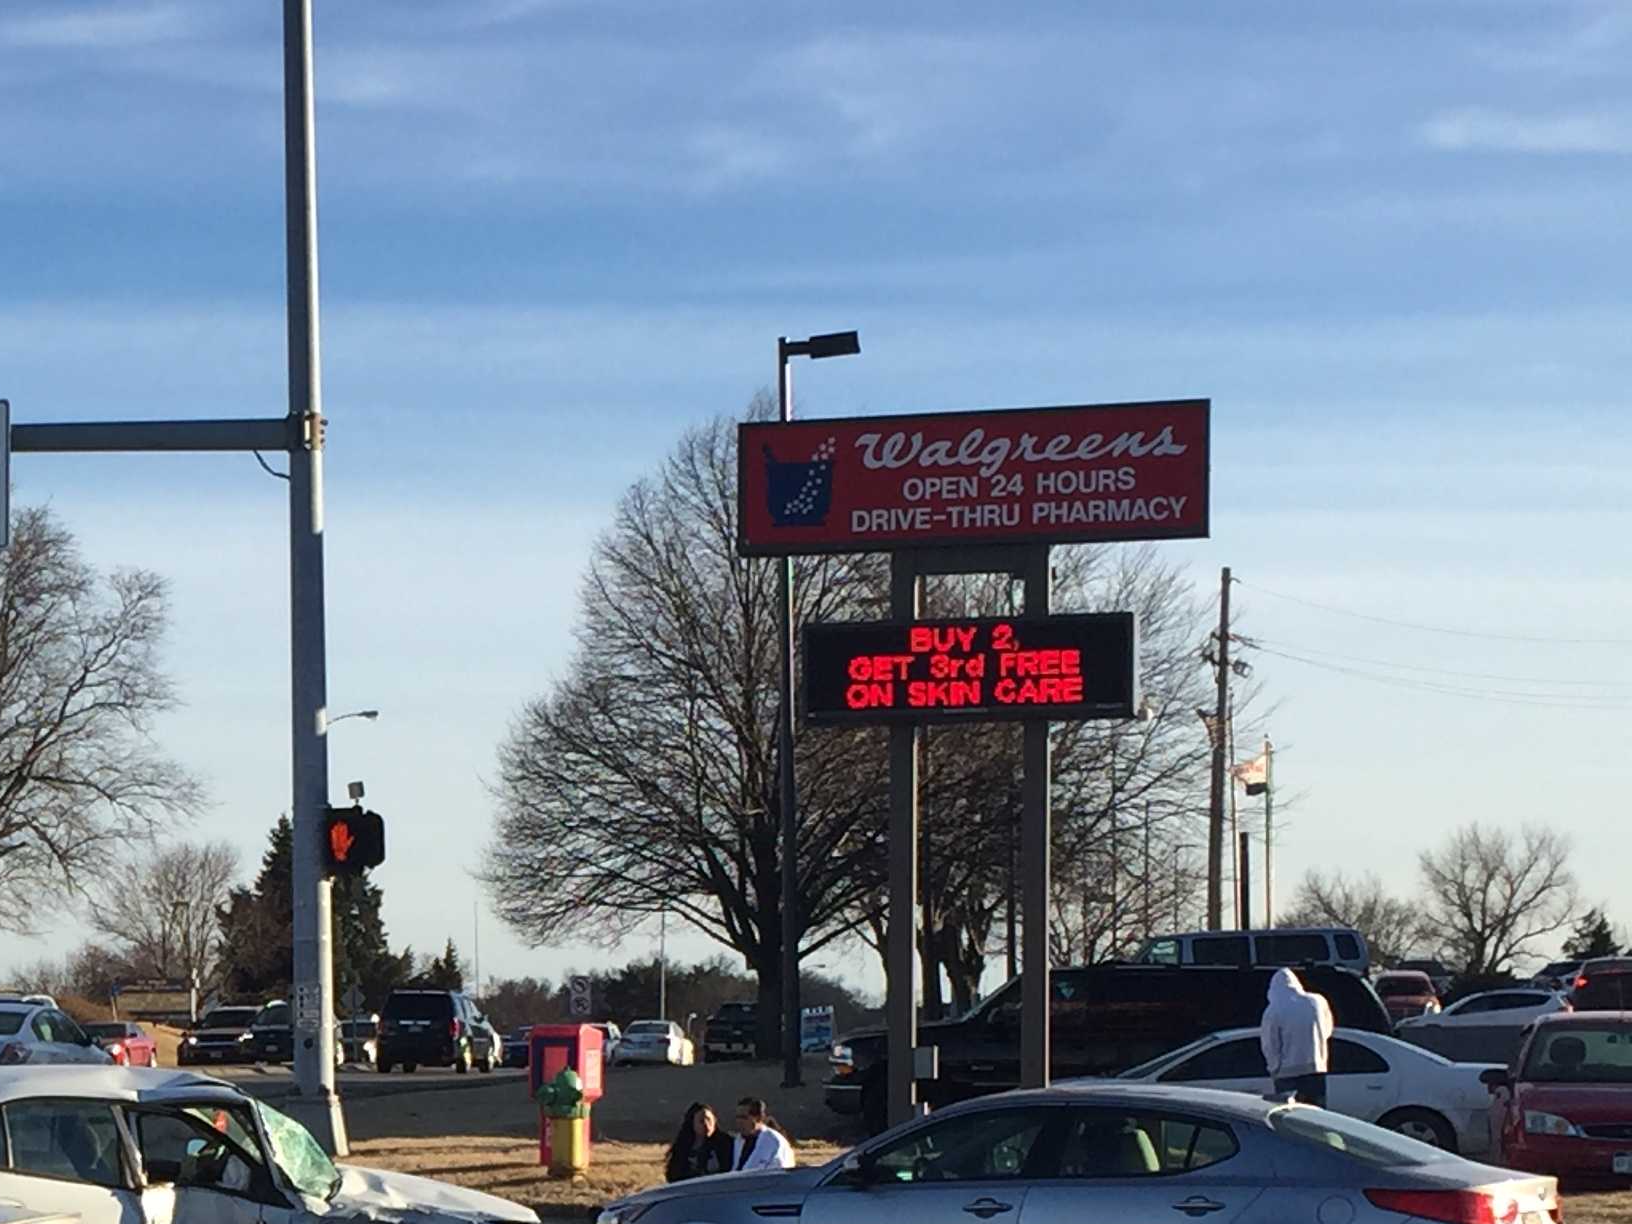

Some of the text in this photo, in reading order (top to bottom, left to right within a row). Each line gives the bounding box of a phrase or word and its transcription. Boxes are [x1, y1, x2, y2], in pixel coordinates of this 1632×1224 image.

[854, 425, 1188, 477] Walgreens
[903, 467, 1136, 501] OPEN 24 HOURS
[851, 496, 1187, 532] DRIVE-THRU PHARMACY
[910, 626, 977, 653] BUY
[847, 650, 1081, 681] GET 3rd FREE
[845, 676, 1084, 709] ON SKIN CARE
